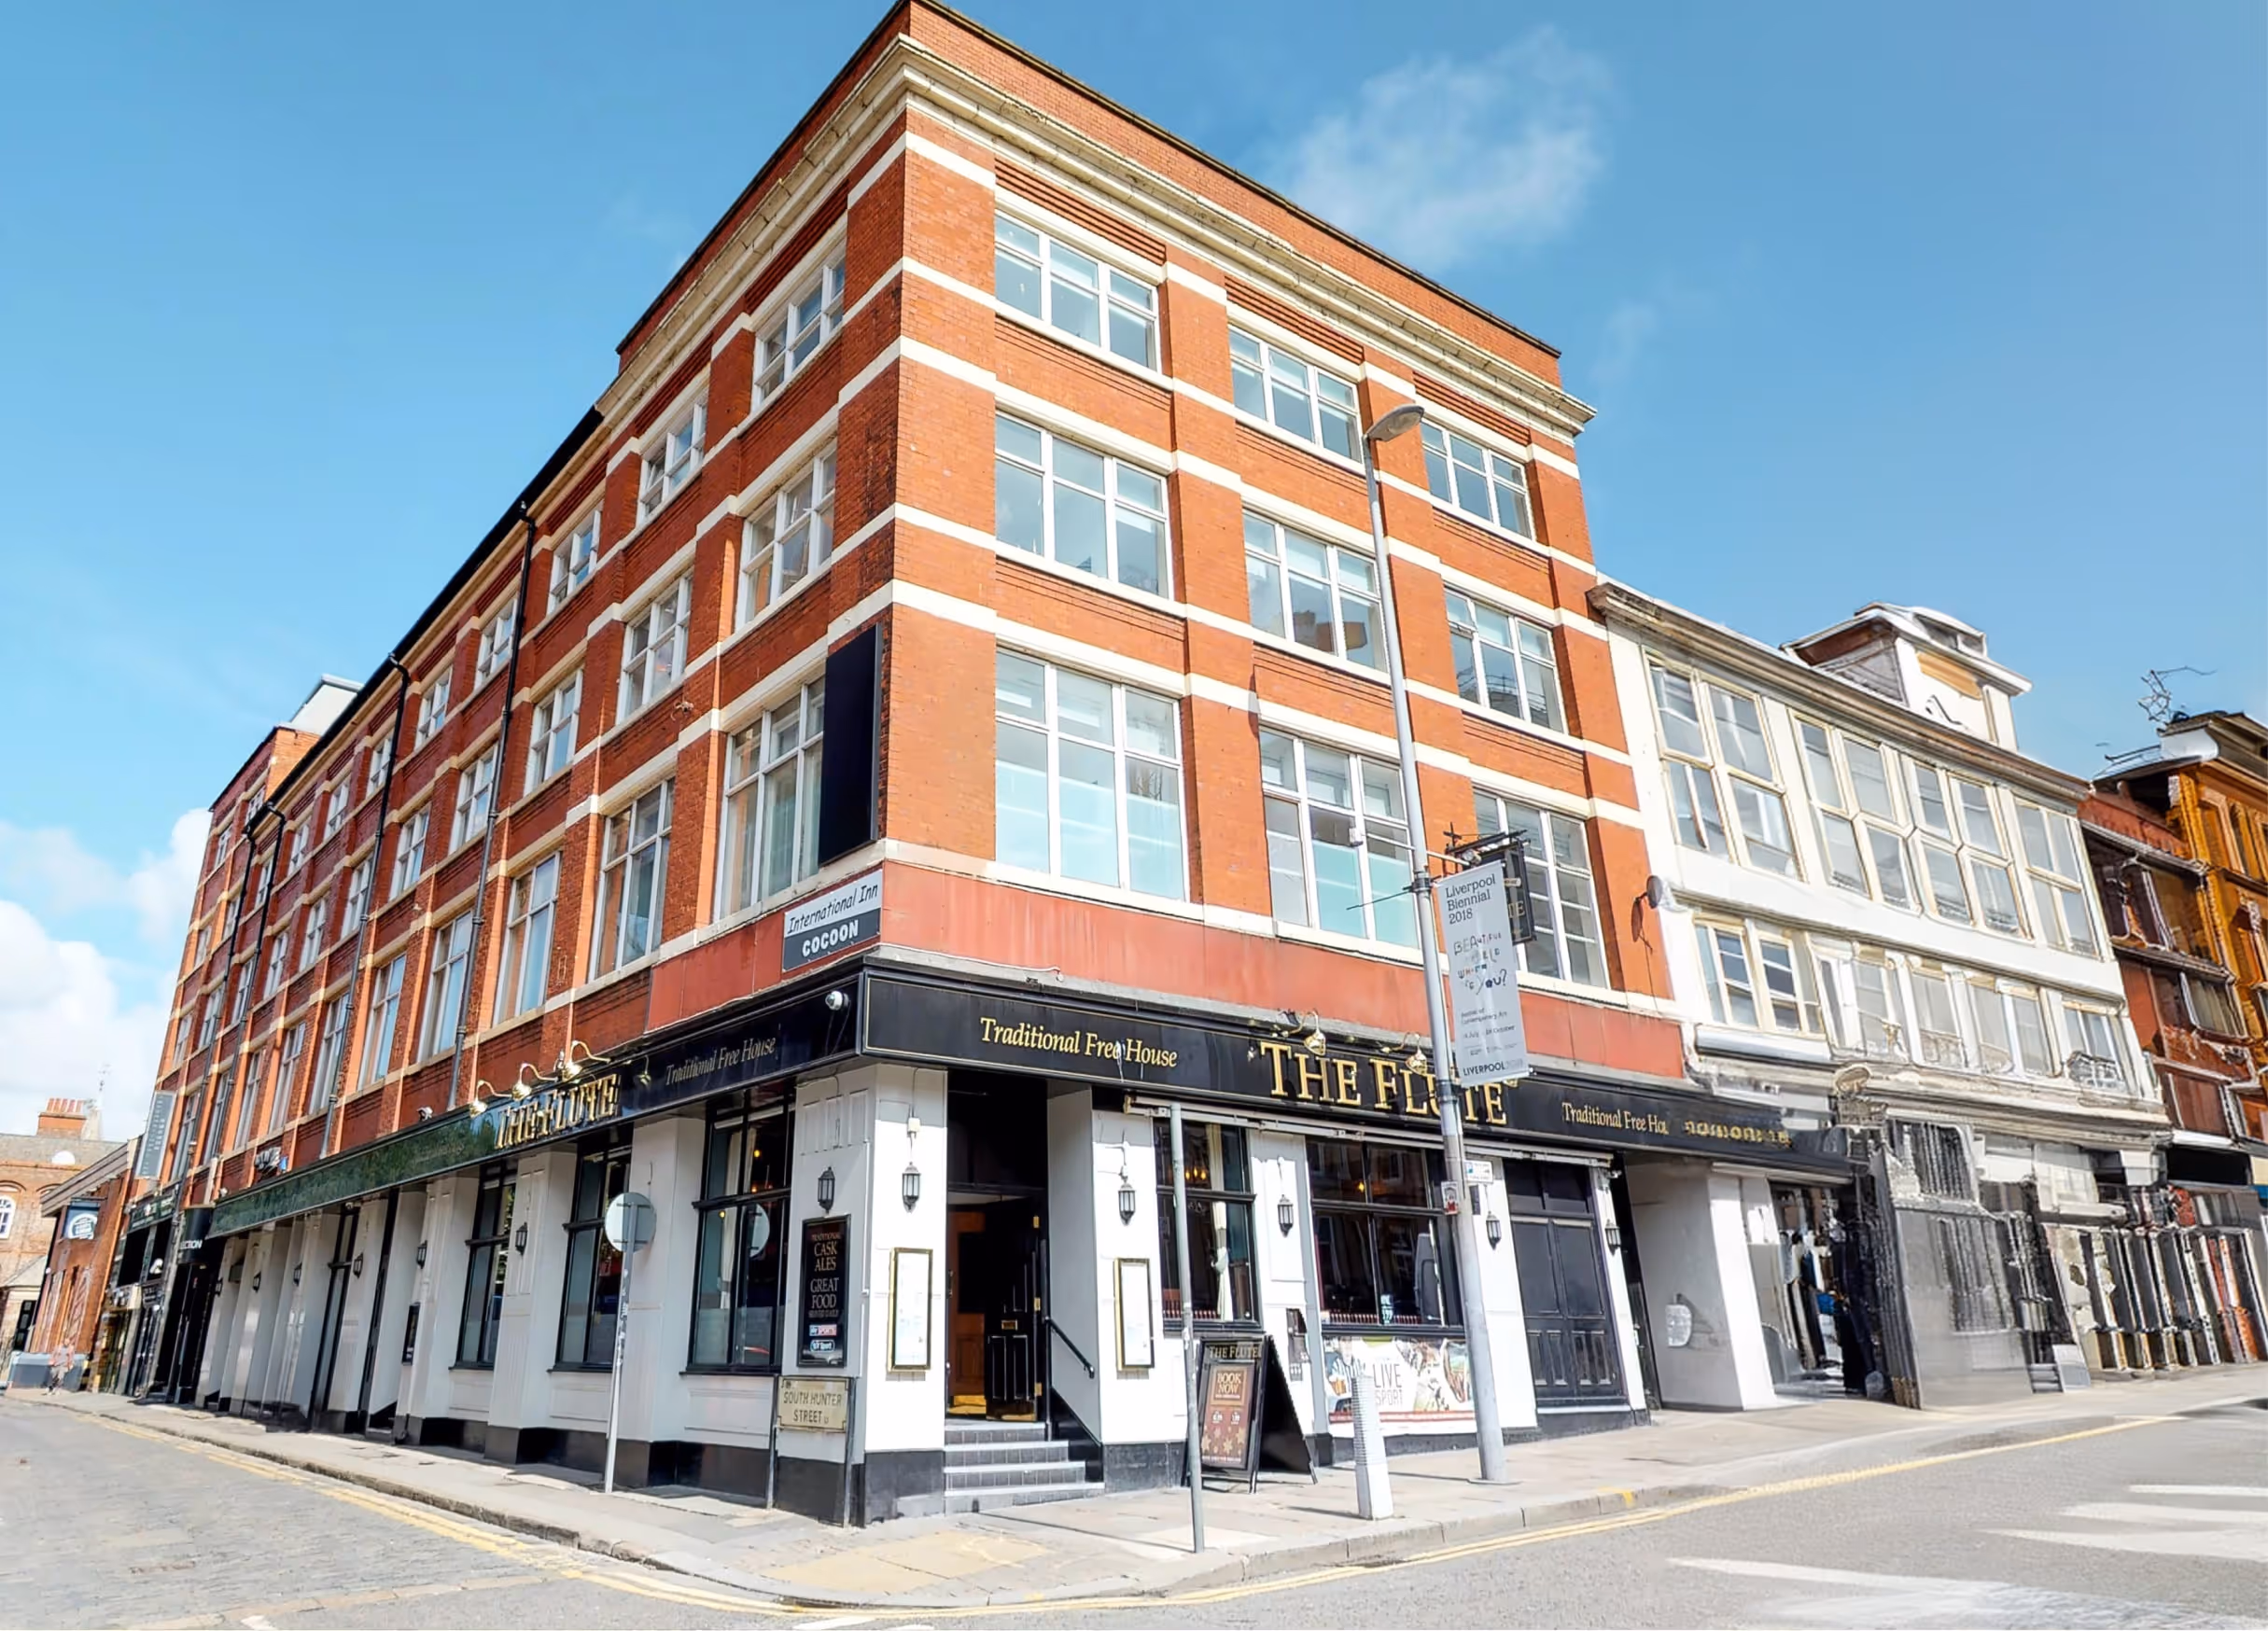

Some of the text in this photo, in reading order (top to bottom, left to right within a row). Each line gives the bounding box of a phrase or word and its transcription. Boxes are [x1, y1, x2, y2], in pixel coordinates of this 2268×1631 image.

[1445, 873, 1496, 899] Liverpool
[1447, 889, 1491, 912] Biennial
[788, 885, 878, 934] International Inn
[1449, 908, 1474, 925] 2018
[803, 920, 859, 957] COCOON
[980, 1017, 1178, 1067] Traditional Free House
[665, 1037, 777, 1086] Traditional Free House
[1463, 1061, 1505, 1076] LIVERPOOL
[1260, 1041, 1362, 1107] THE
[1561, 1101, 1622, 1129] Traditional
[1623, 1110, 1646, 1133] Free
[814, 1240, 837, 1257] CASK
[814, 1256, 836, 1272] ALES
[810, 1277, 839, 1293] GREAT
[811, 1293, 837, 1309] FOOD
[1210, 1345, 1228, 1359] THE
[1217, 1373, 1241, 1384] BOOK
[1372, 1363, 1403, 1388] LIVE
[1218, 1383, 1239, 1395] NOW
[783, 1390, 843, 1407] SOUTH HUNTER
[792, 1409, 822, 1424] STREET
